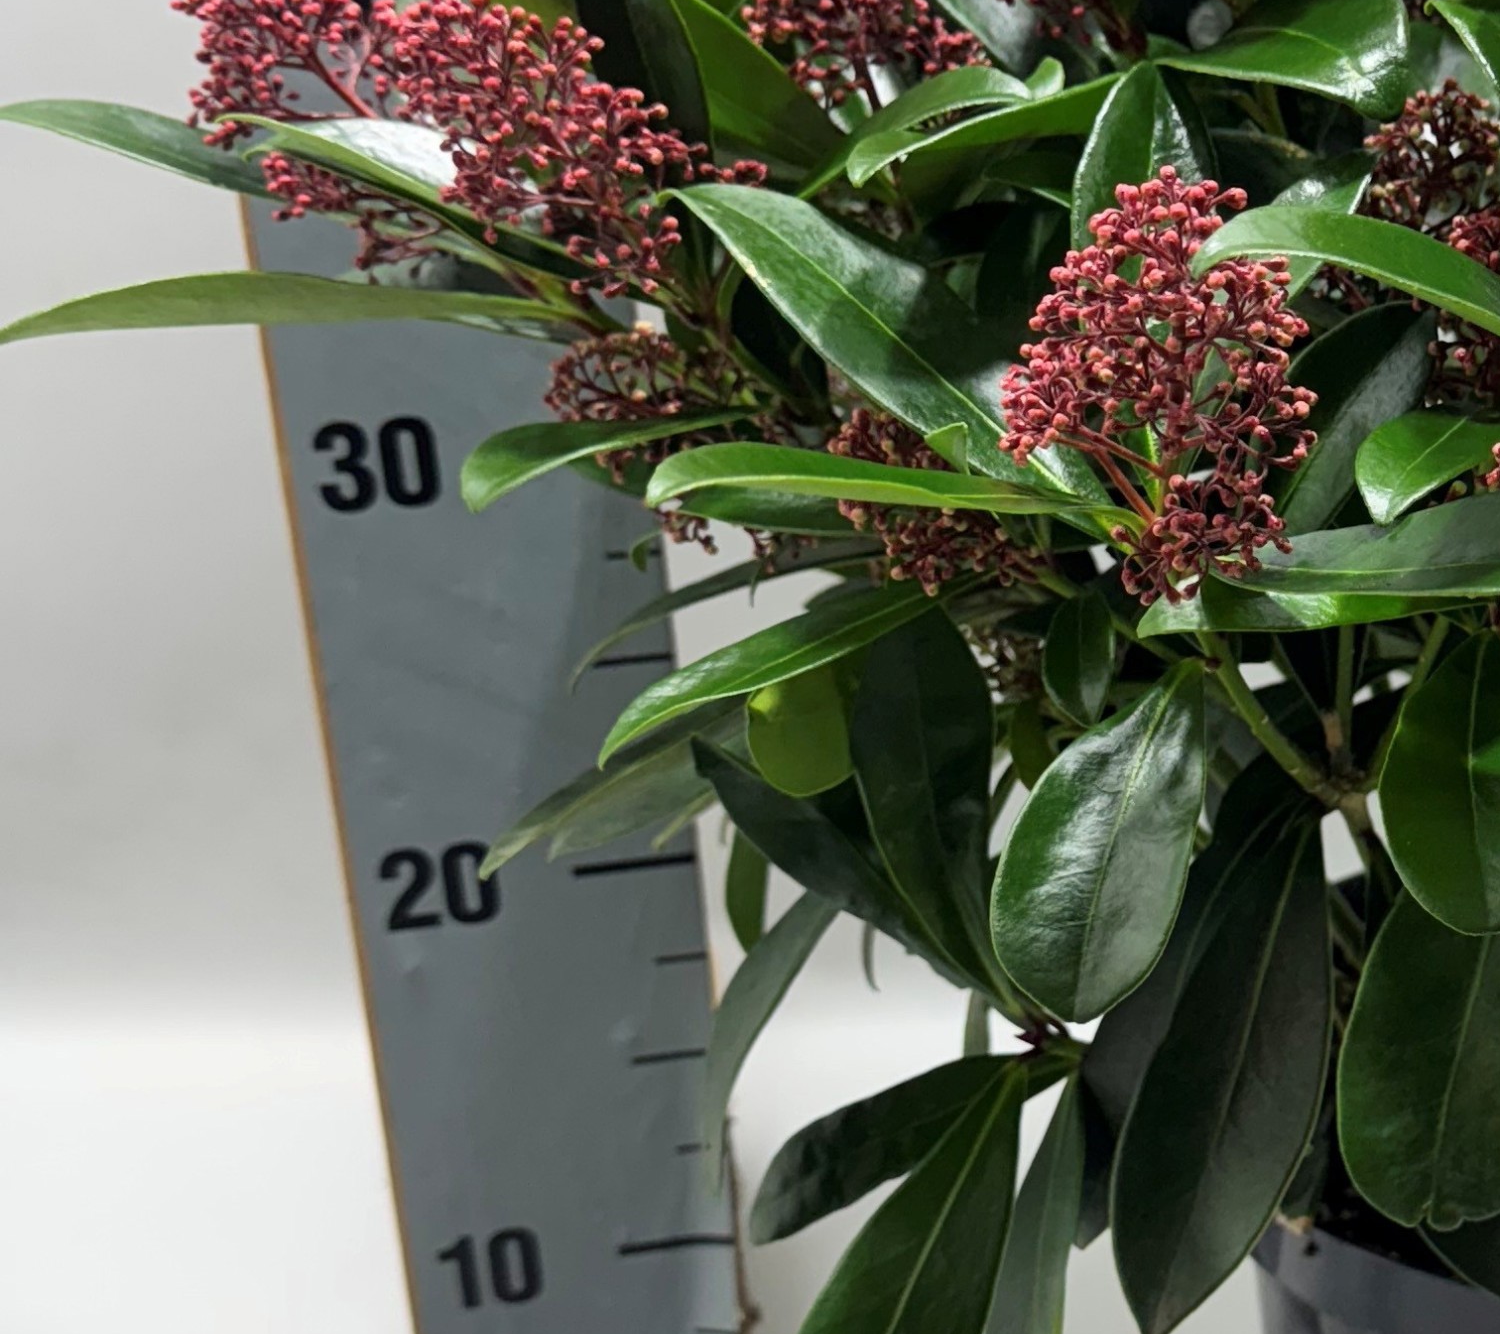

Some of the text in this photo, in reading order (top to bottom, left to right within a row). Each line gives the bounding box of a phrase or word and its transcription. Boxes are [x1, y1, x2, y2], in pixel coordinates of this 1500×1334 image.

[313, 415, 440, 514] 30
[379, 840, 501, 931] 20
[437, 1227, 543, 1310] 10
